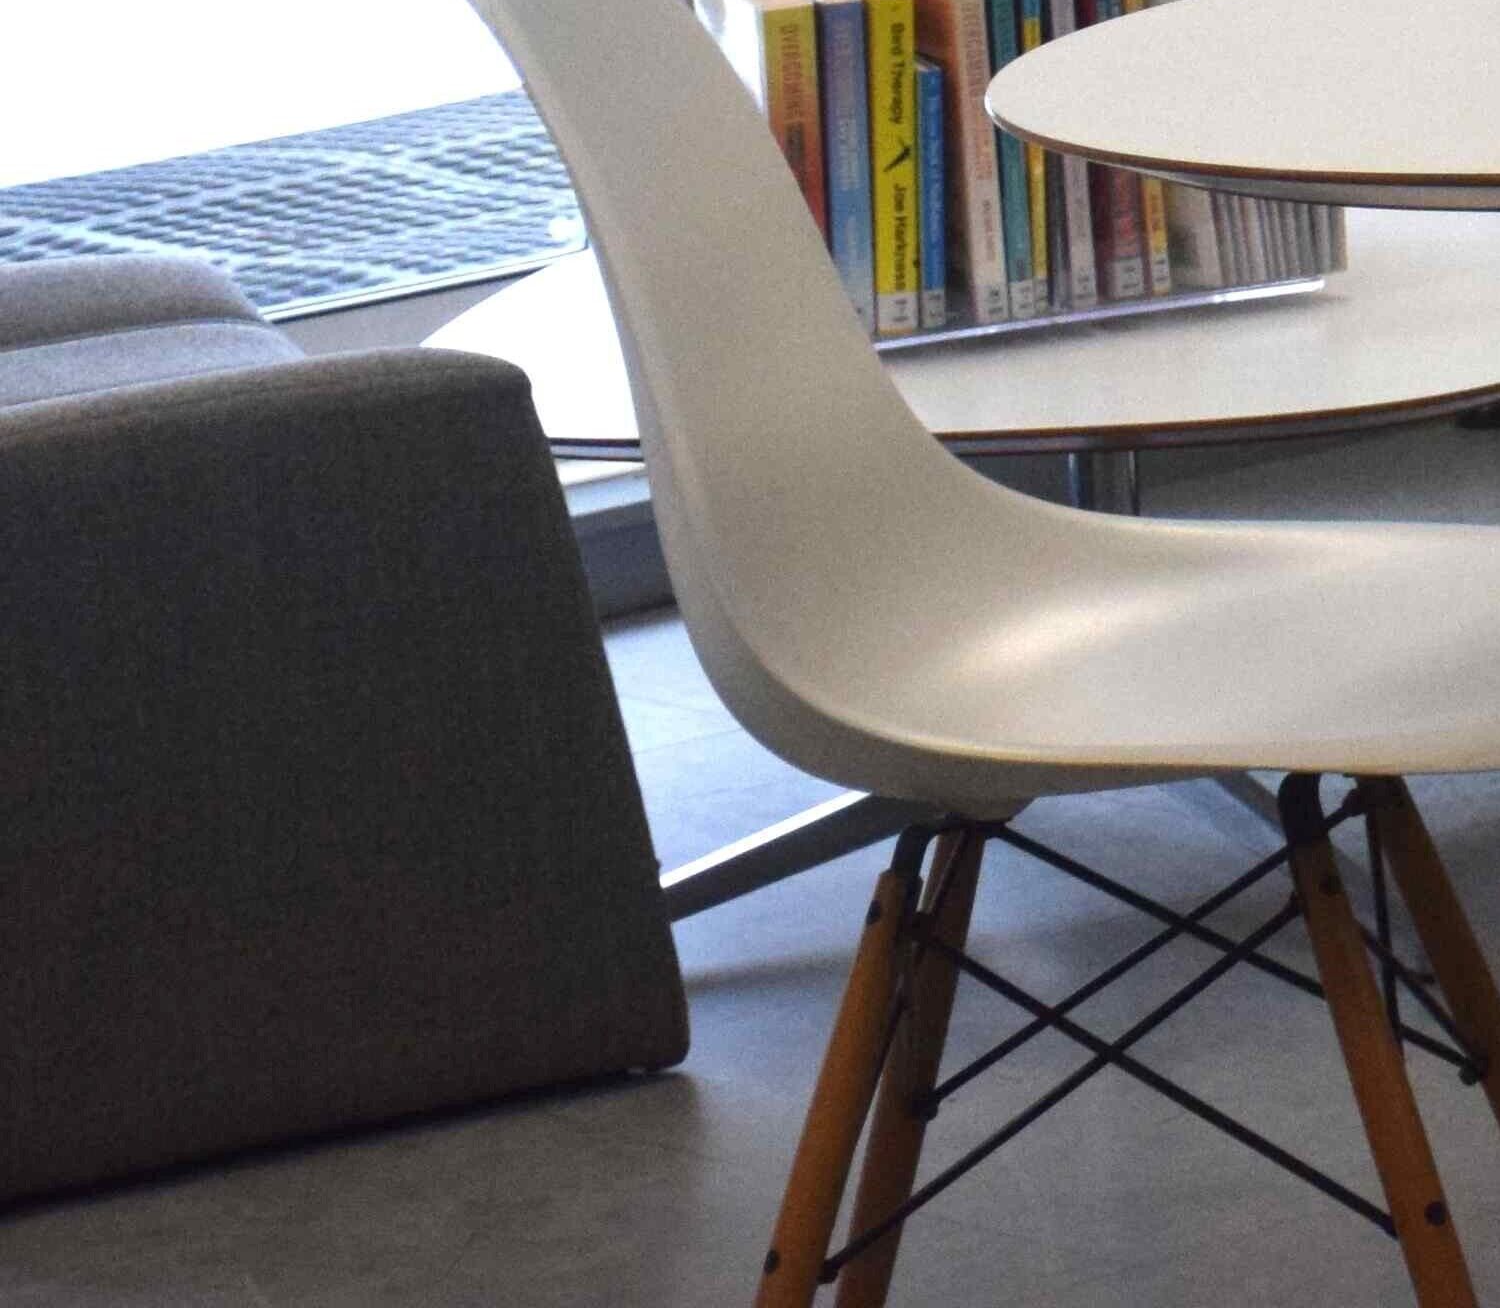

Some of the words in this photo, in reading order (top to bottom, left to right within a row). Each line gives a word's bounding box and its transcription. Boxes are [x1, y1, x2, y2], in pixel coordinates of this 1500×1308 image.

[891, 21, 906, 59] Bird
[888, 60, 906, 125] Therapy
[892, 182, 907, 213] Joe
[893, 216, 909, 293] Harkness
